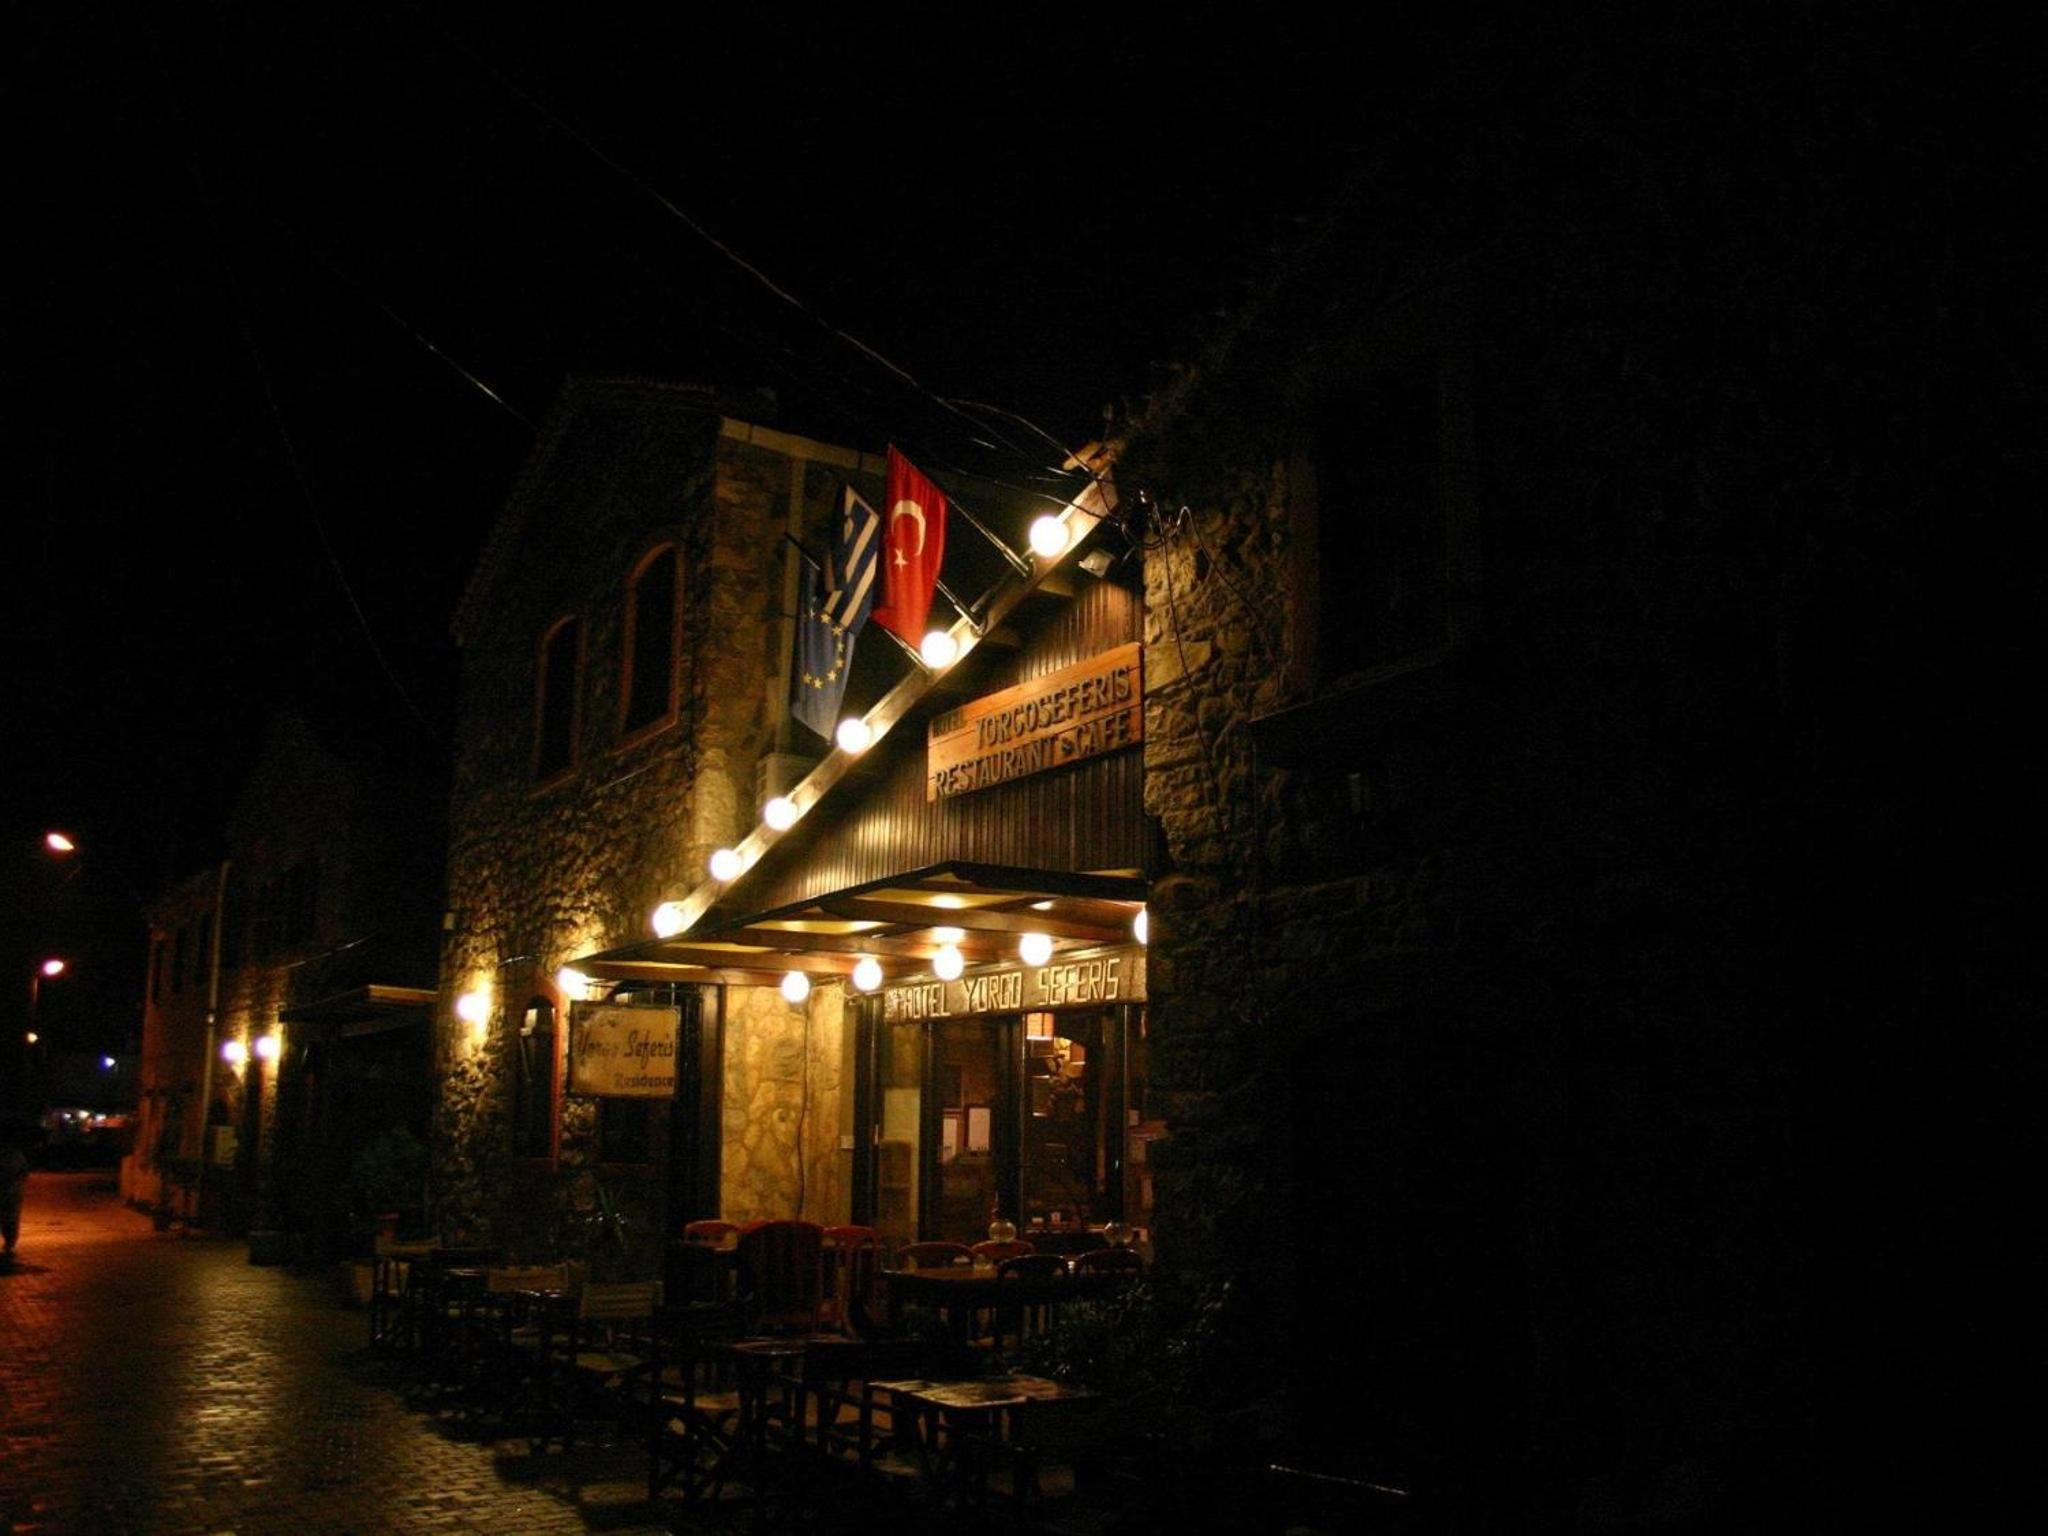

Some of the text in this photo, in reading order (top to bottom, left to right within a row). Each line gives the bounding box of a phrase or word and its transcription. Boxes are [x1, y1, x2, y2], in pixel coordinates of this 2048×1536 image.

[936, 736, 1057, 799] RESTAURANT
[1075, 710, 1132, 754] CAFE
[903, 958, 1120, 1019] HOTEL YORGO SEFERIS
[623, 1029, 673, 1070] Seferis
